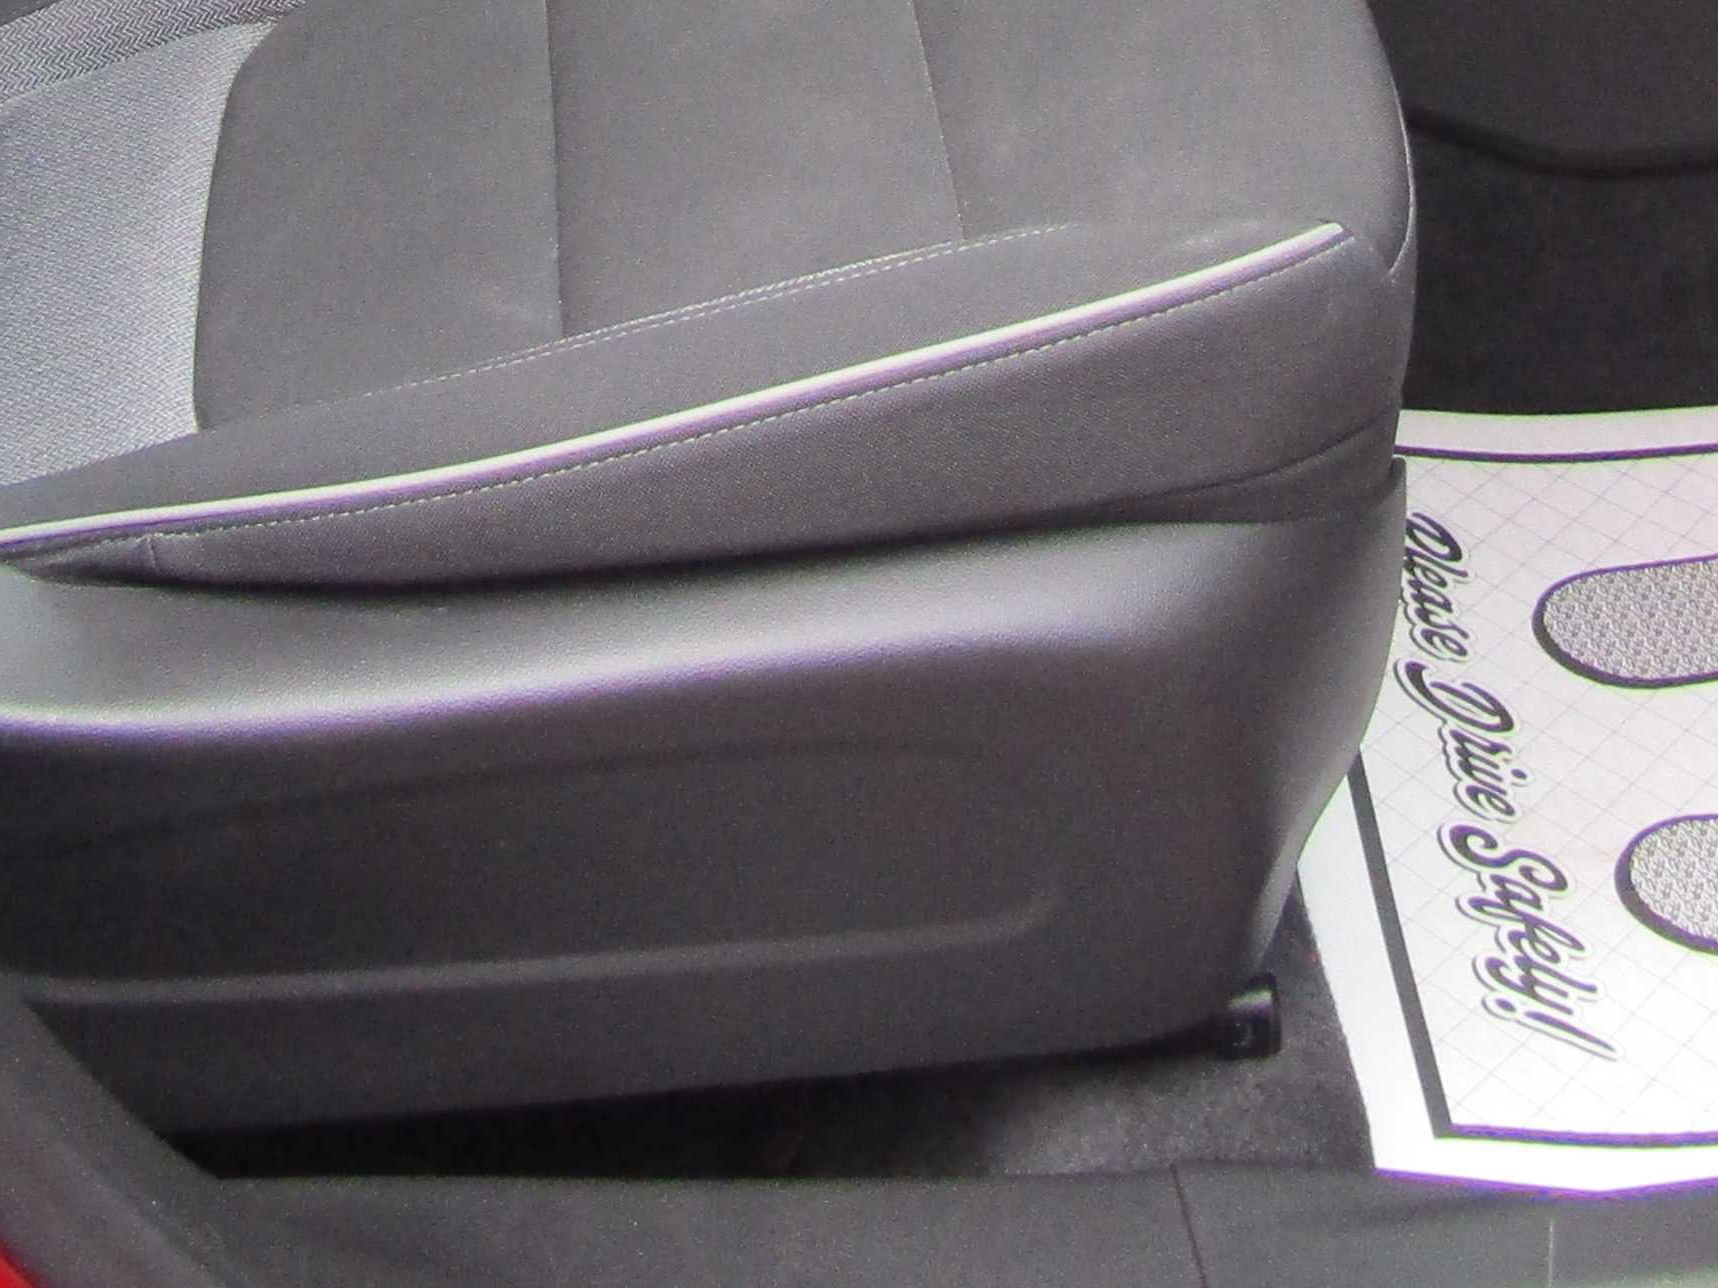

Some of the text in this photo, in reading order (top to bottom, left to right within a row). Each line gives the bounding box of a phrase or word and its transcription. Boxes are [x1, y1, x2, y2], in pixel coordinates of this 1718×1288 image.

[1398, 511, 1618, 1056] Please Drive Safely!
